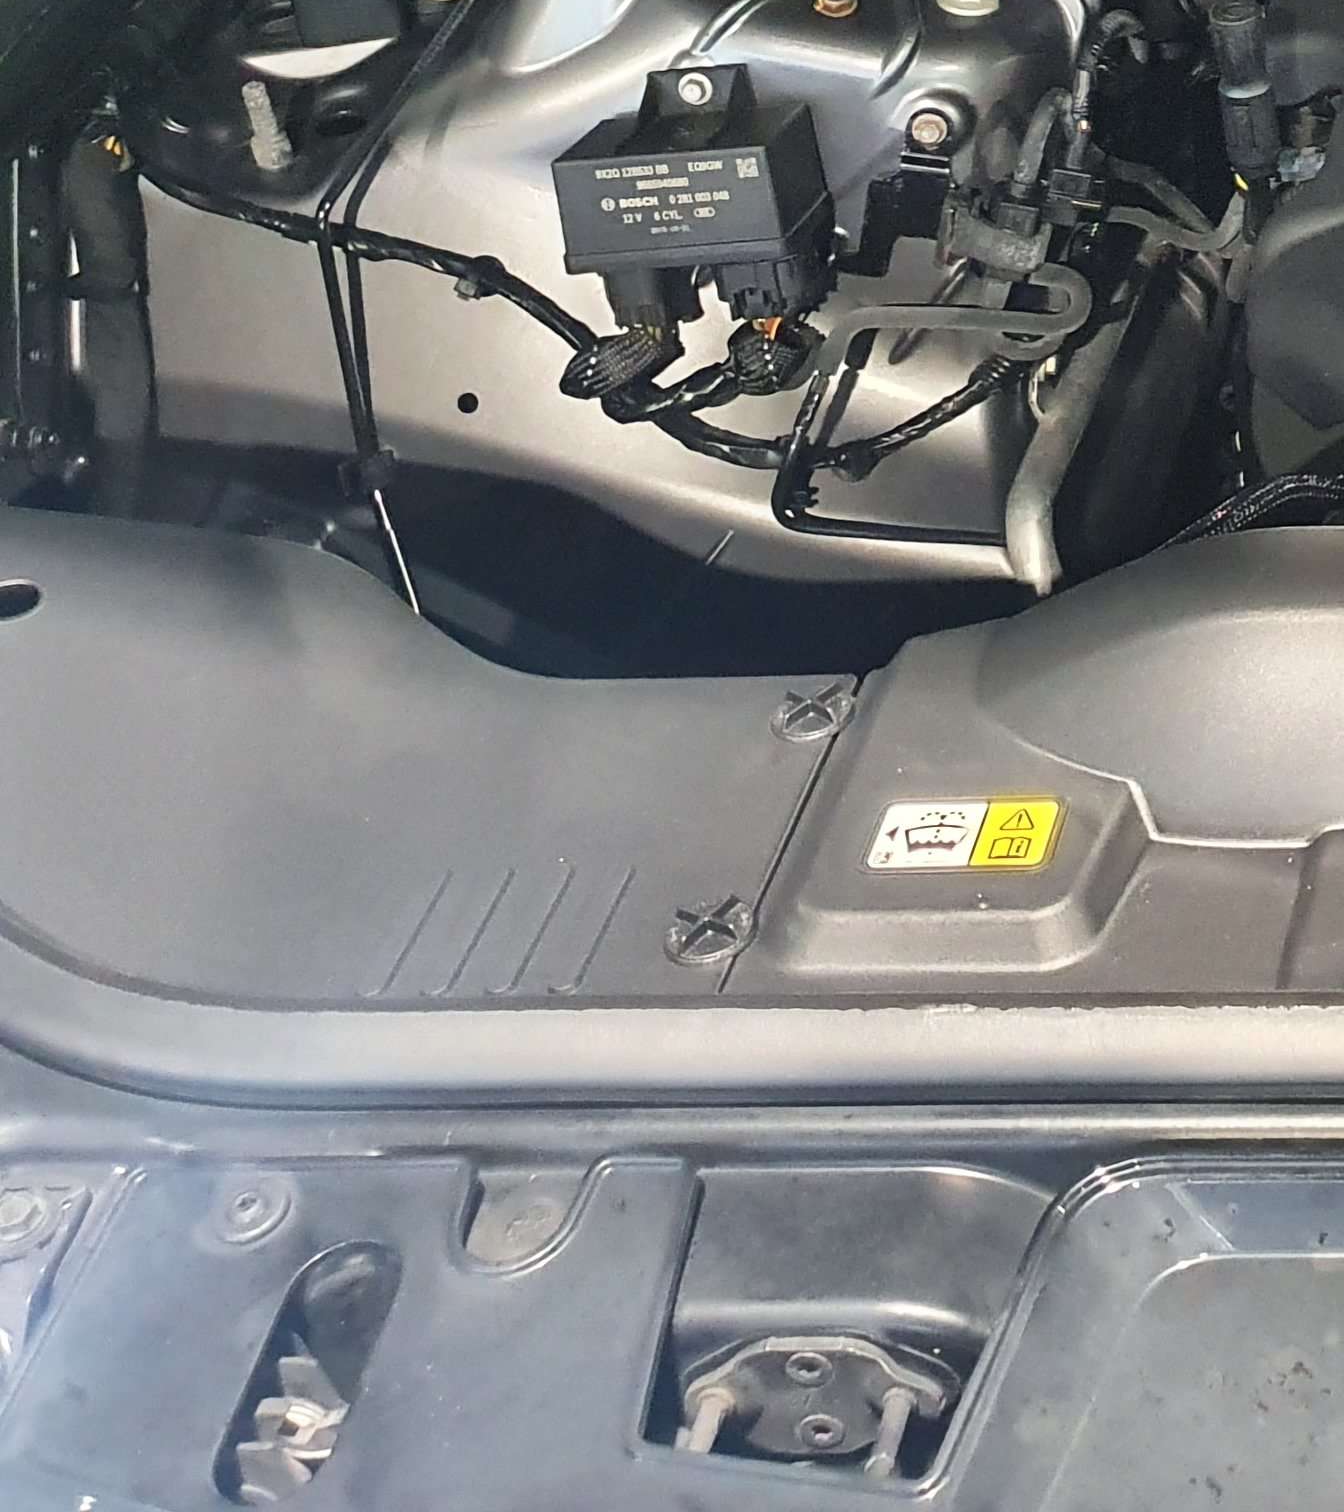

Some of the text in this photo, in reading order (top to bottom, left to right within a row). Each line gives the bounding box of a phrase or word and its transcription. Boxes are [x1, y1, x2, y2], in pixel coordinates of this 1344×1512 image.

[619, 197, 658, 208] BOSCH
[623, 214, 633, 223] 12
[635, 213, 642, 222] V
